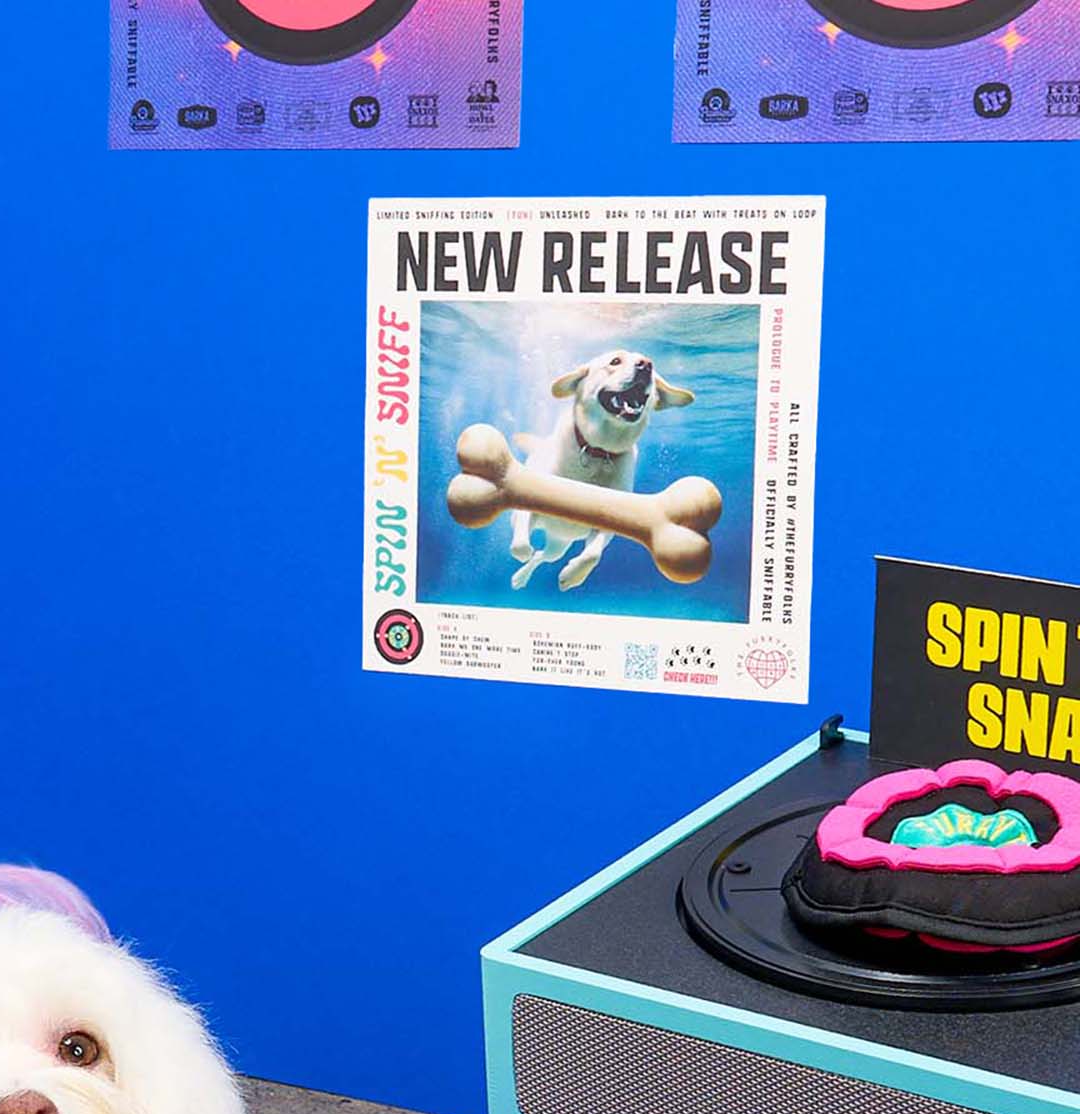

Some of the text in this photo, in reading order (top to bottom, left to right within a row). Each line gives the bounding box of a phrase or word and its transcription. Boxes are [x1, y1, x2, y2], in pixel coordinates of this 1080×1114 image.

[376, 210, 494, 221] LIMITED SNIFFING EDITION
[539, 210, 591, 221] UNLEASHED
[605, 209, 818, 220] BARK TO THE BEAT WITH TREATS ON LOOP
[396, 230, 791, 296] NEW RELEASE
[376, 304, 411, 426] SNIFF
[767, 308, 785, 464] PROLOGUE TO PLAYTIME
[373, 498, 409, 598] SPIN
[761, 479, 777, 624] OFFICIALLY SNIFFABLE
[782, 402, 801, 626] ALL CRAFTED BY #THEFURRYFOLKS
[926, 600, 1069, 687] SPIN
